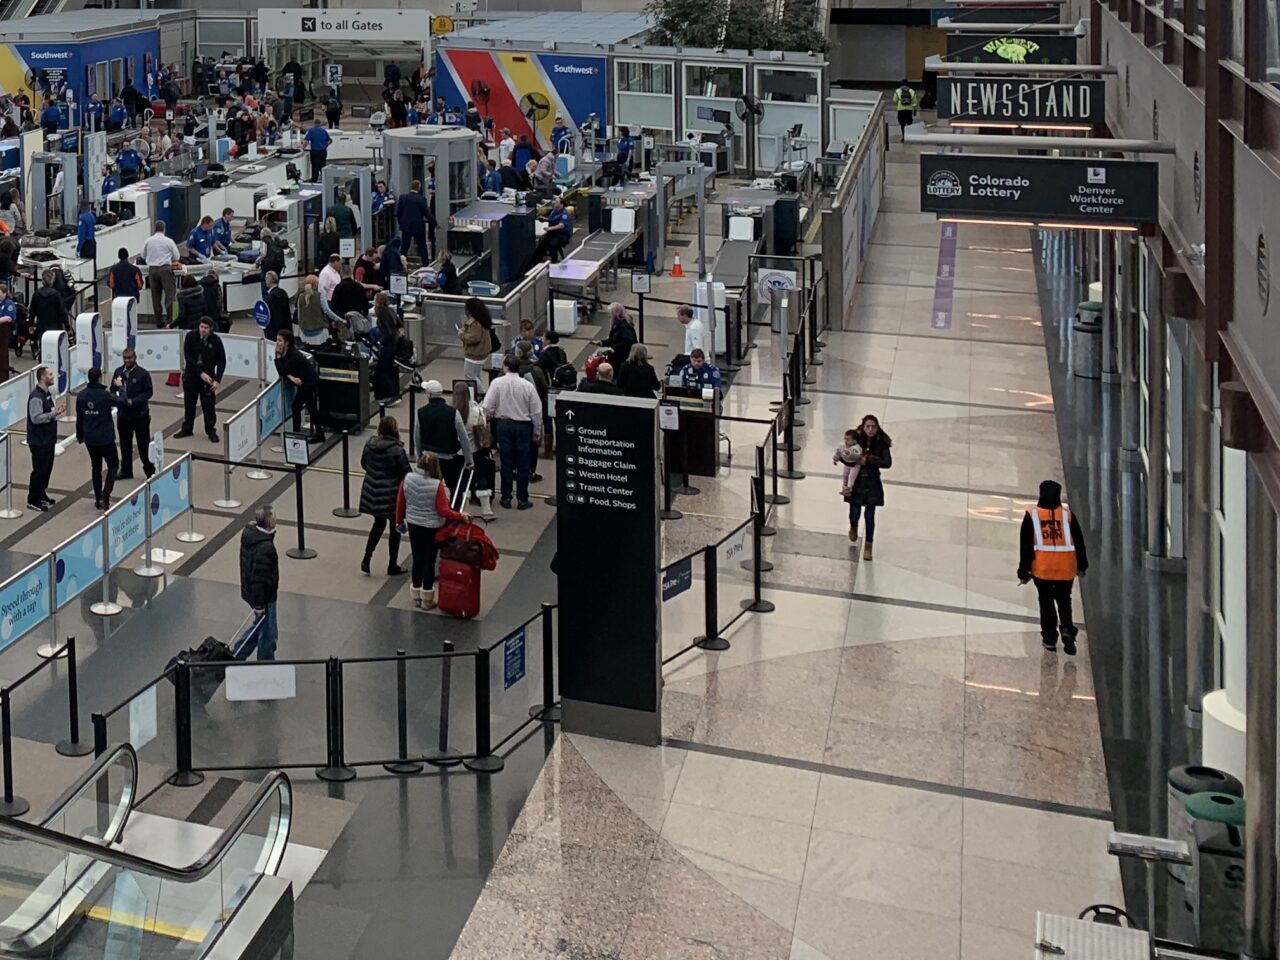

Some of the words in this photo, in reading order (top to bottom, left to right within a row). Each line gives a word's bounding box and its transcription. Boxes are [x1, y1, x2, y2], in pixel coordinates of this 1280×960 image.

[321, 20, 332, 30] to
[335, 20, 348, 30] all
[351, 20, 383, 31] Gates
[554, 64, 593, 75] Southwest
[950, 82, 1091, 118] NEWSSTAND
[969, 174, 1030, 187] Colorado
[928, 186, 961, 195] LOTTERY
[970, 186, 1021, 200] Lottery
[1078, 185, 1116, 195] Denver
[1070, 194, 1124, 205] Workforce
[1080, 204, 1114, 214] Center
[577, 426, 607, 437] Ground
[578, 435, 635, 449] Transportation
[578, 445, 622, 456] Information
[578, 456, 612, 469] Baggage
[613, 461, 636, 470] Claim
[579, 470, 605, 480] Westin
[607, 473, 628, 483] Hotel
[579, 483, 605, 493] Transit
[607, 486, 634, 496] Center
[589, 497, 611, 507] Food,
[612, 499, 636, 510] Shops
[1, 594, 20, 617] Speed
[20, 578, 43, 604] through
[9, 609, 23, 627] with
[27, 601, 37, 614] tap
